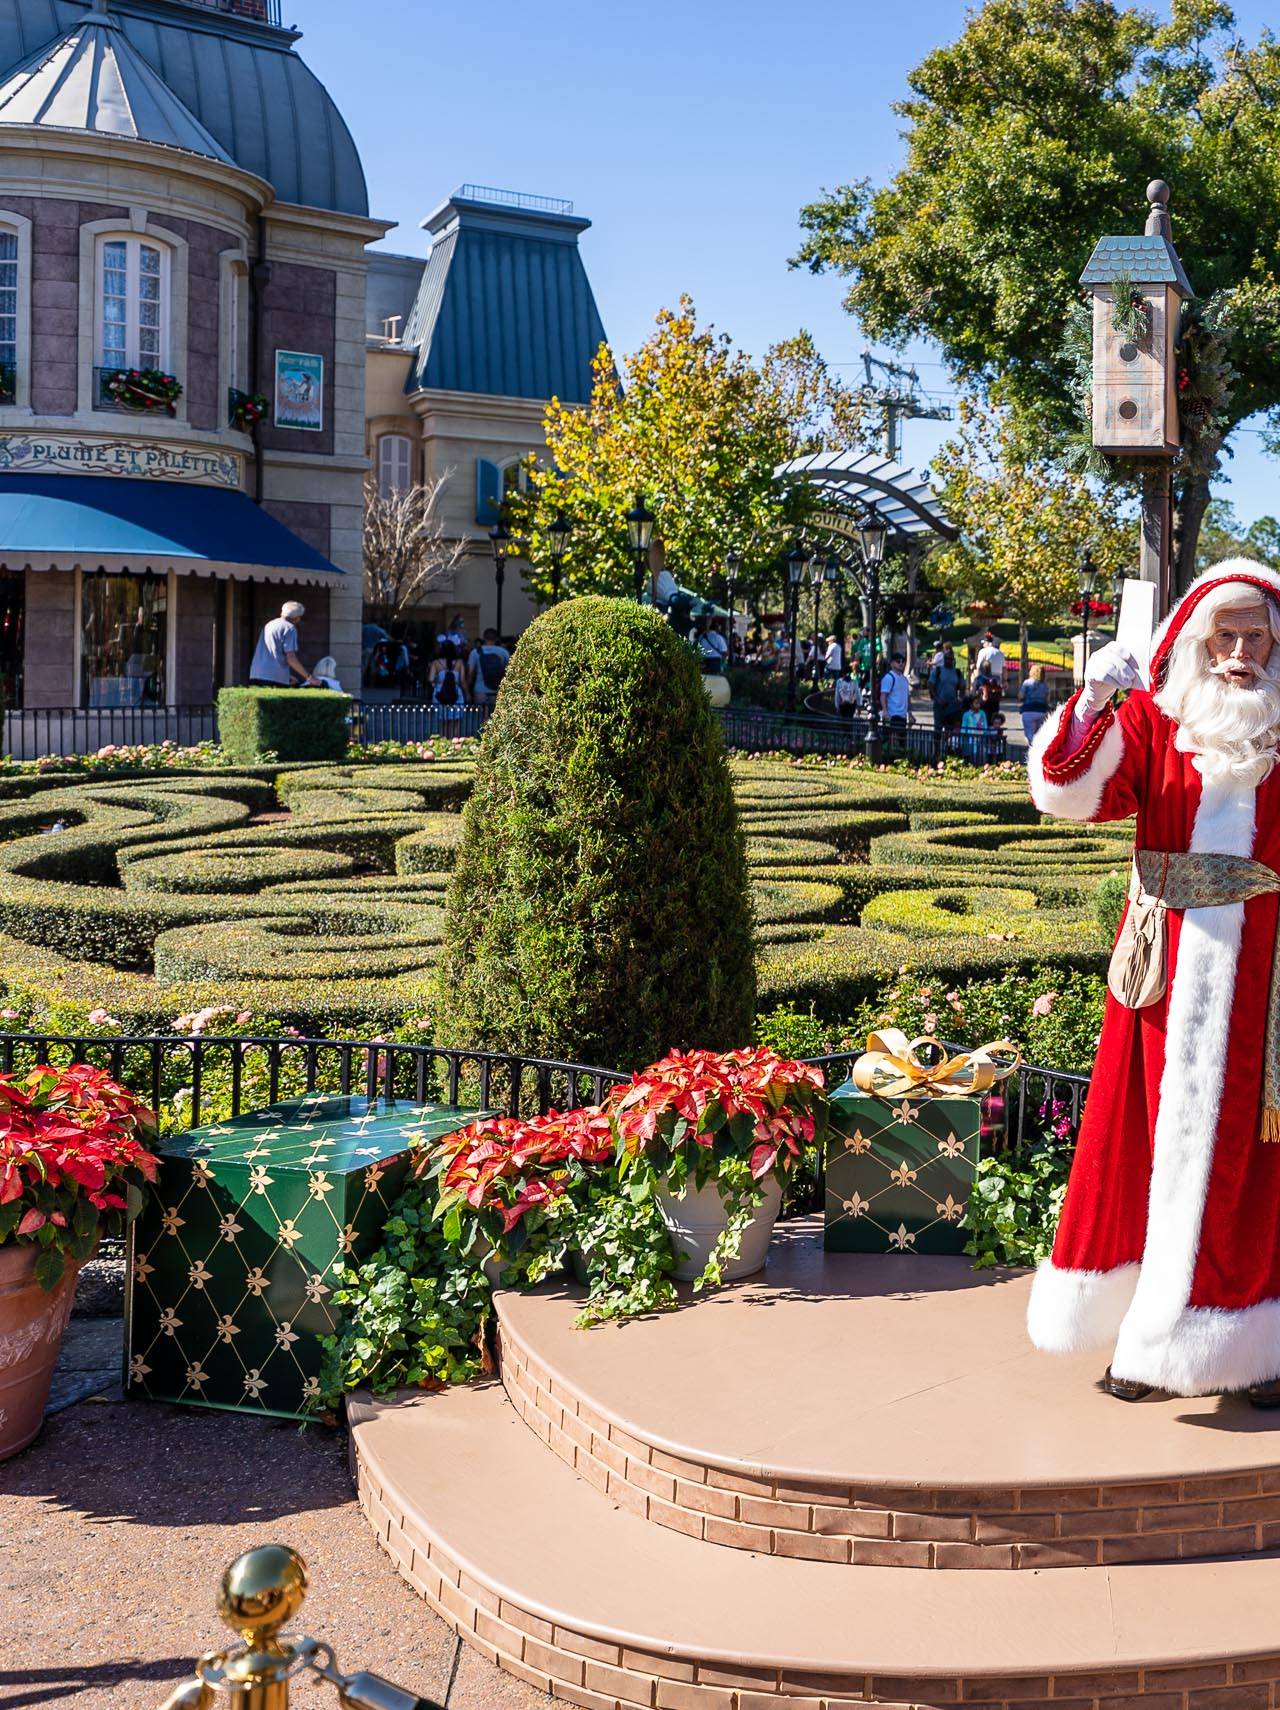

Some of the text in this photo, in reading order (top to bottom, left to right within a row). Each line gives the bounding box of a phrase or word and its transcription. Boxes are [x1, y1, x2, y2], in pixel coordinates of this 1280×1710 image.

[33, 444, 219, 473] PLUME ET PALETTE
